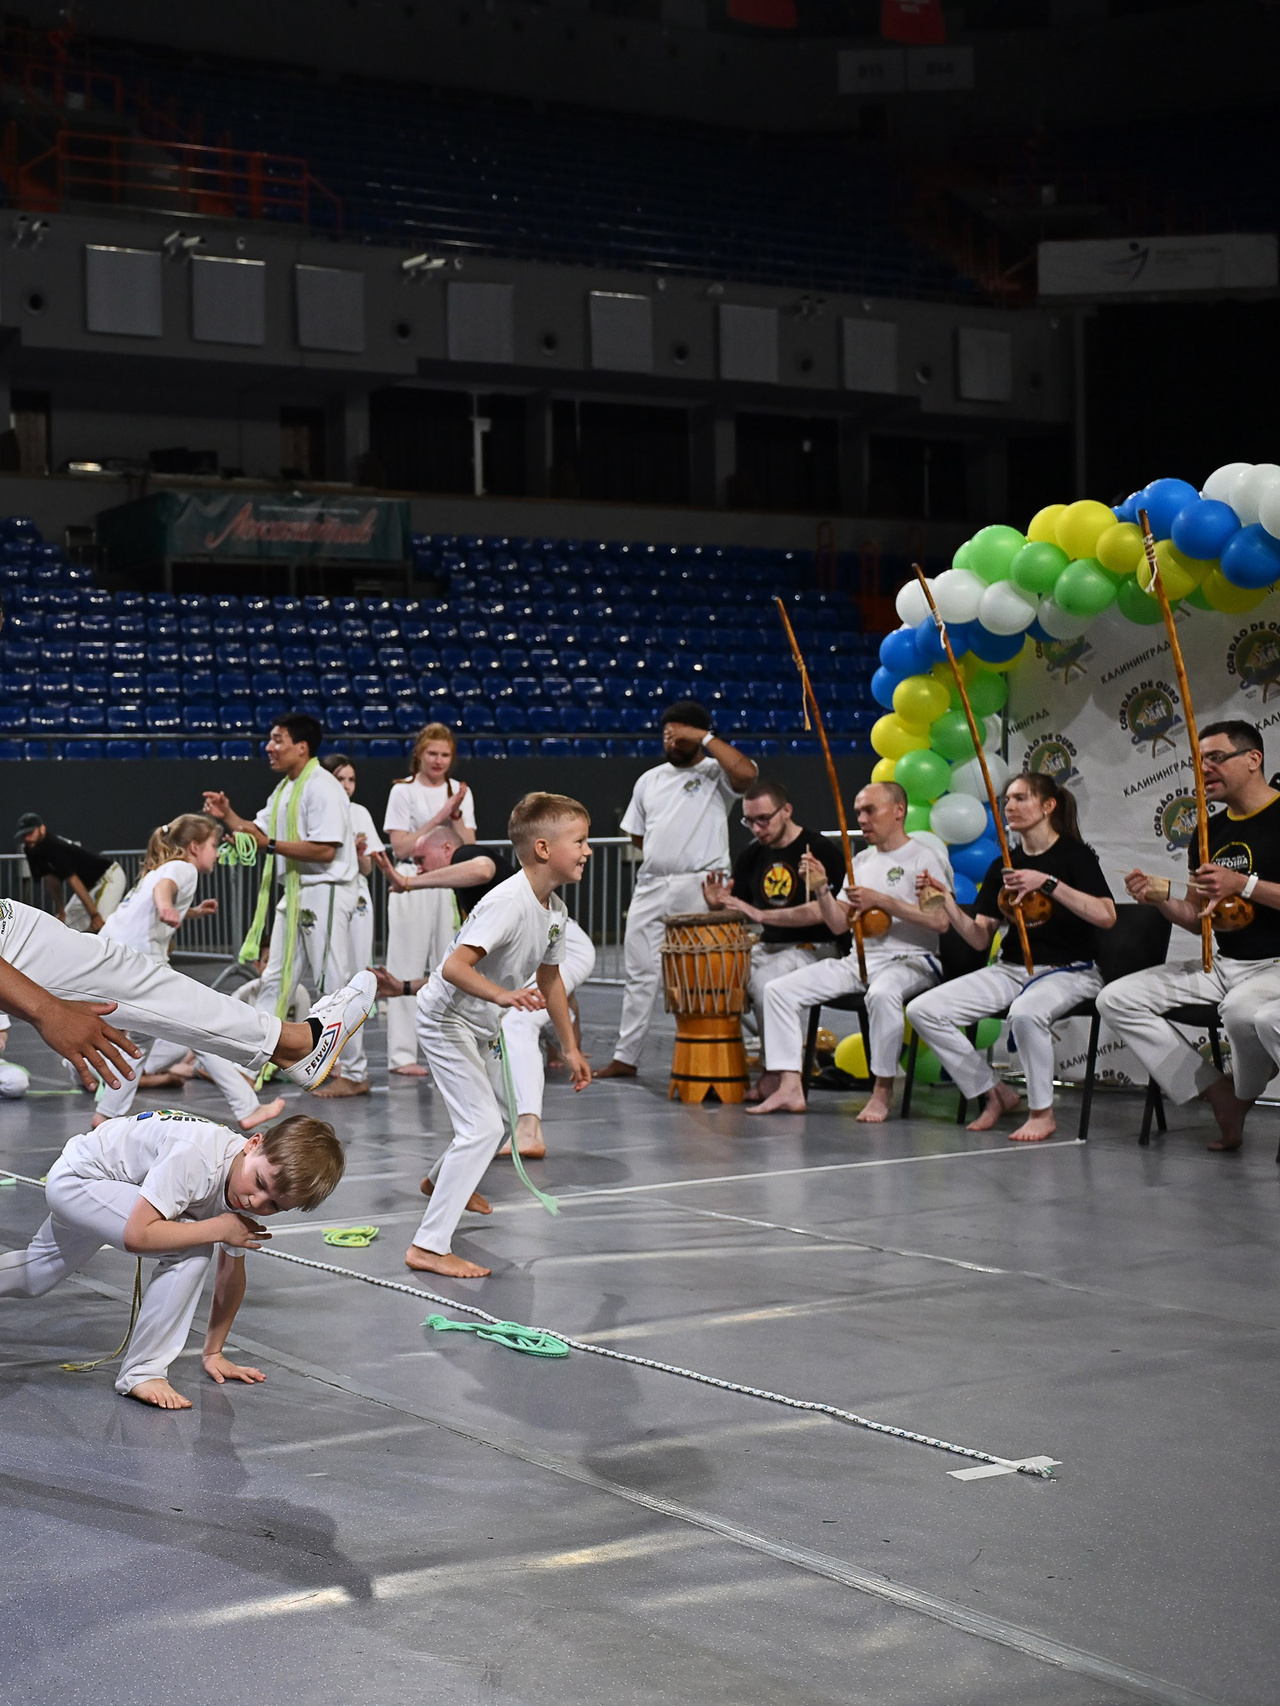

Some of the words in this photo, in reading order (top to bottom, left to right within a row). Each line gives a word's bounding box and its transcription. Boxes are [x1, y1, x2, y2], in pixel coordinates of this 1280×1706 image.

[1250, 621, 1266, 632] DE
[1100, 640, 1171, 685] КАЛИНИНГРАД
[1140, 679, 1154, 690] DE
[1155, 680, 1180, 704] OURO
[1040, 732, 1054, 743] DE
[1055, 734, 1077, 757] OURO
[1123, 756, 1195, 798] КАЛИНИНГРАД
[1175, 787, 1189, 797] DE
[304, 1039, 330, 1076] FEIYUE
